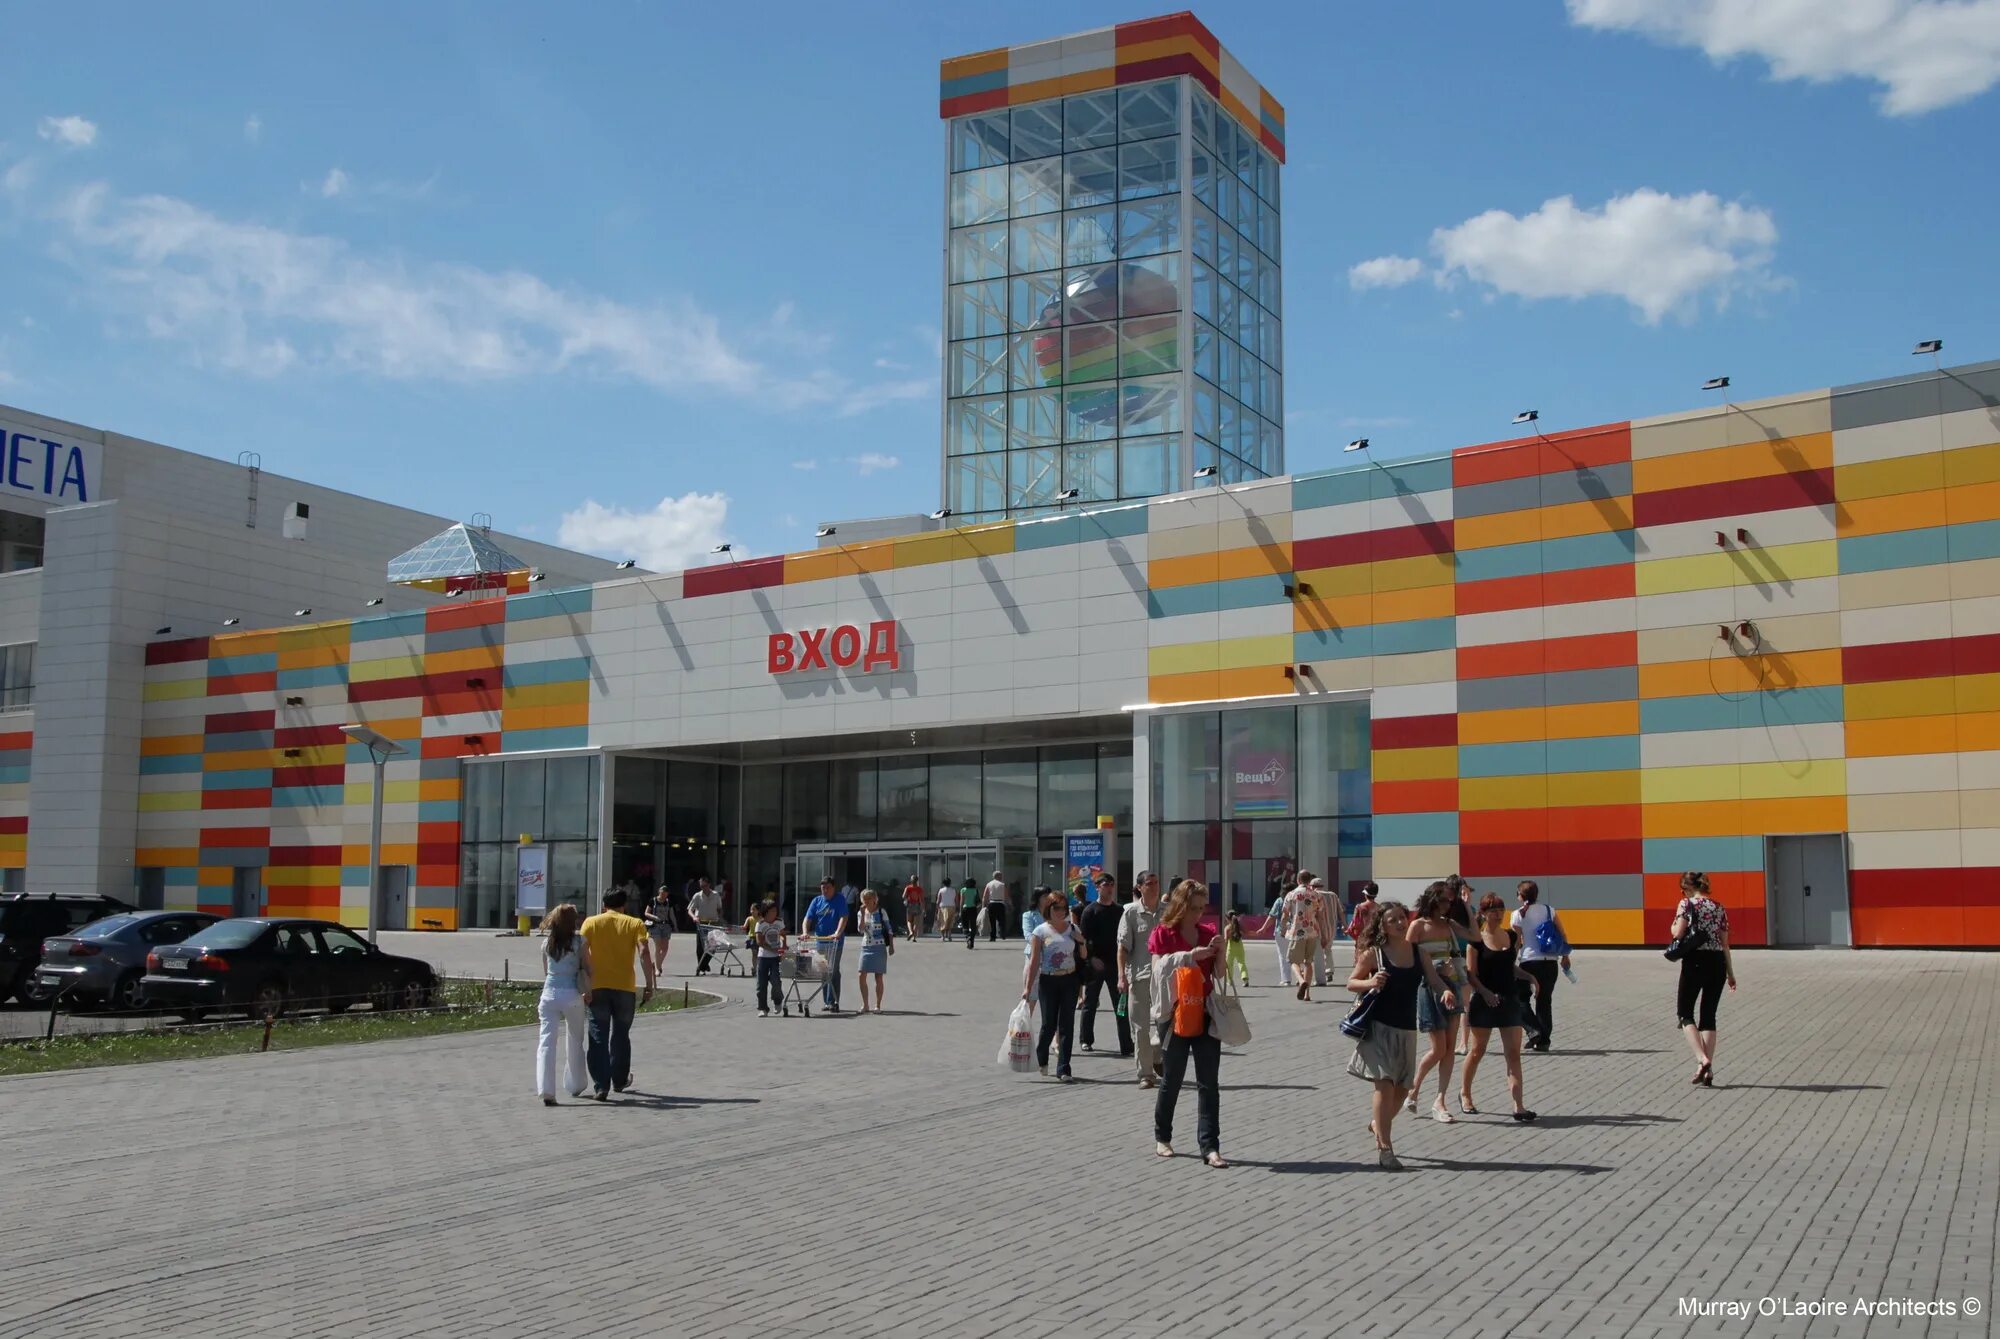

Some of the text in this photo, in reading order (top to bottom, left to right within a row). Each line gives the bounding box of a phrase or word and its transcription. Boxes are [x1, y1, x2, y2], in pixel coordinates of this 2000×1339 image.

[0, 429, 88, 502] ЕТА
[768, 620, 899, 673] ВХОД
[1235, 770, 1276, 785] Вещь!
